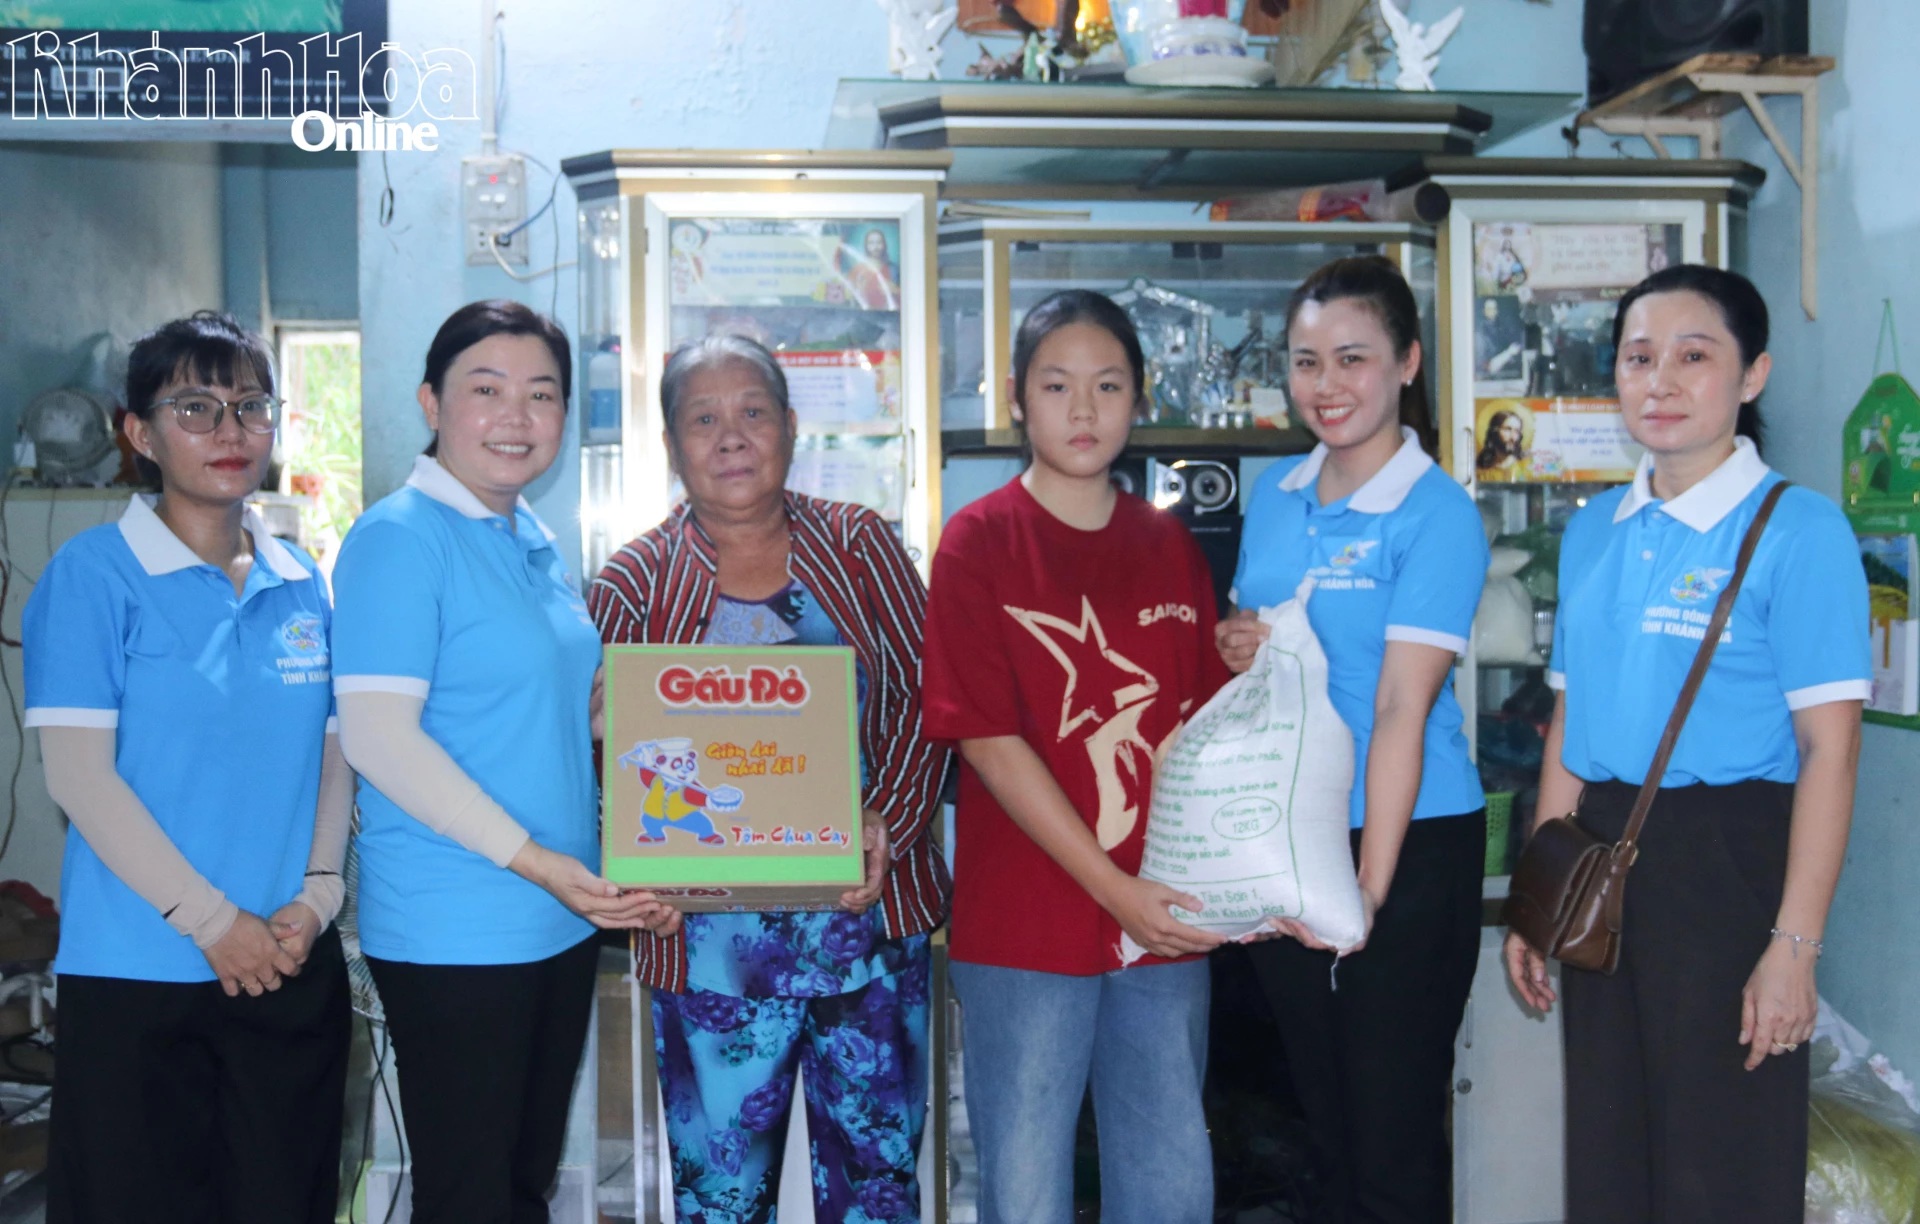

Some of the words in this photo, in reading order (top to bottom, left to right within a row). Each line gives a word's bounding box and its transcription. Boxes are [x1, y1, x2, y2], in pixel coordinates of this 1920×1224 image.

[657, 665, 747, 707] Gấu
[748, 665, 810, 708] Đỏ
[731, 826, 766, 845] Tôm
[770, 825, 814, 845] Chua
[818, 825, 849, 847] Cay
[1232, 819, 1260, 834] 12KG
[1222, 905, 1258, 919] Khánh
[1261, 902, 1285, 914] Hòa
